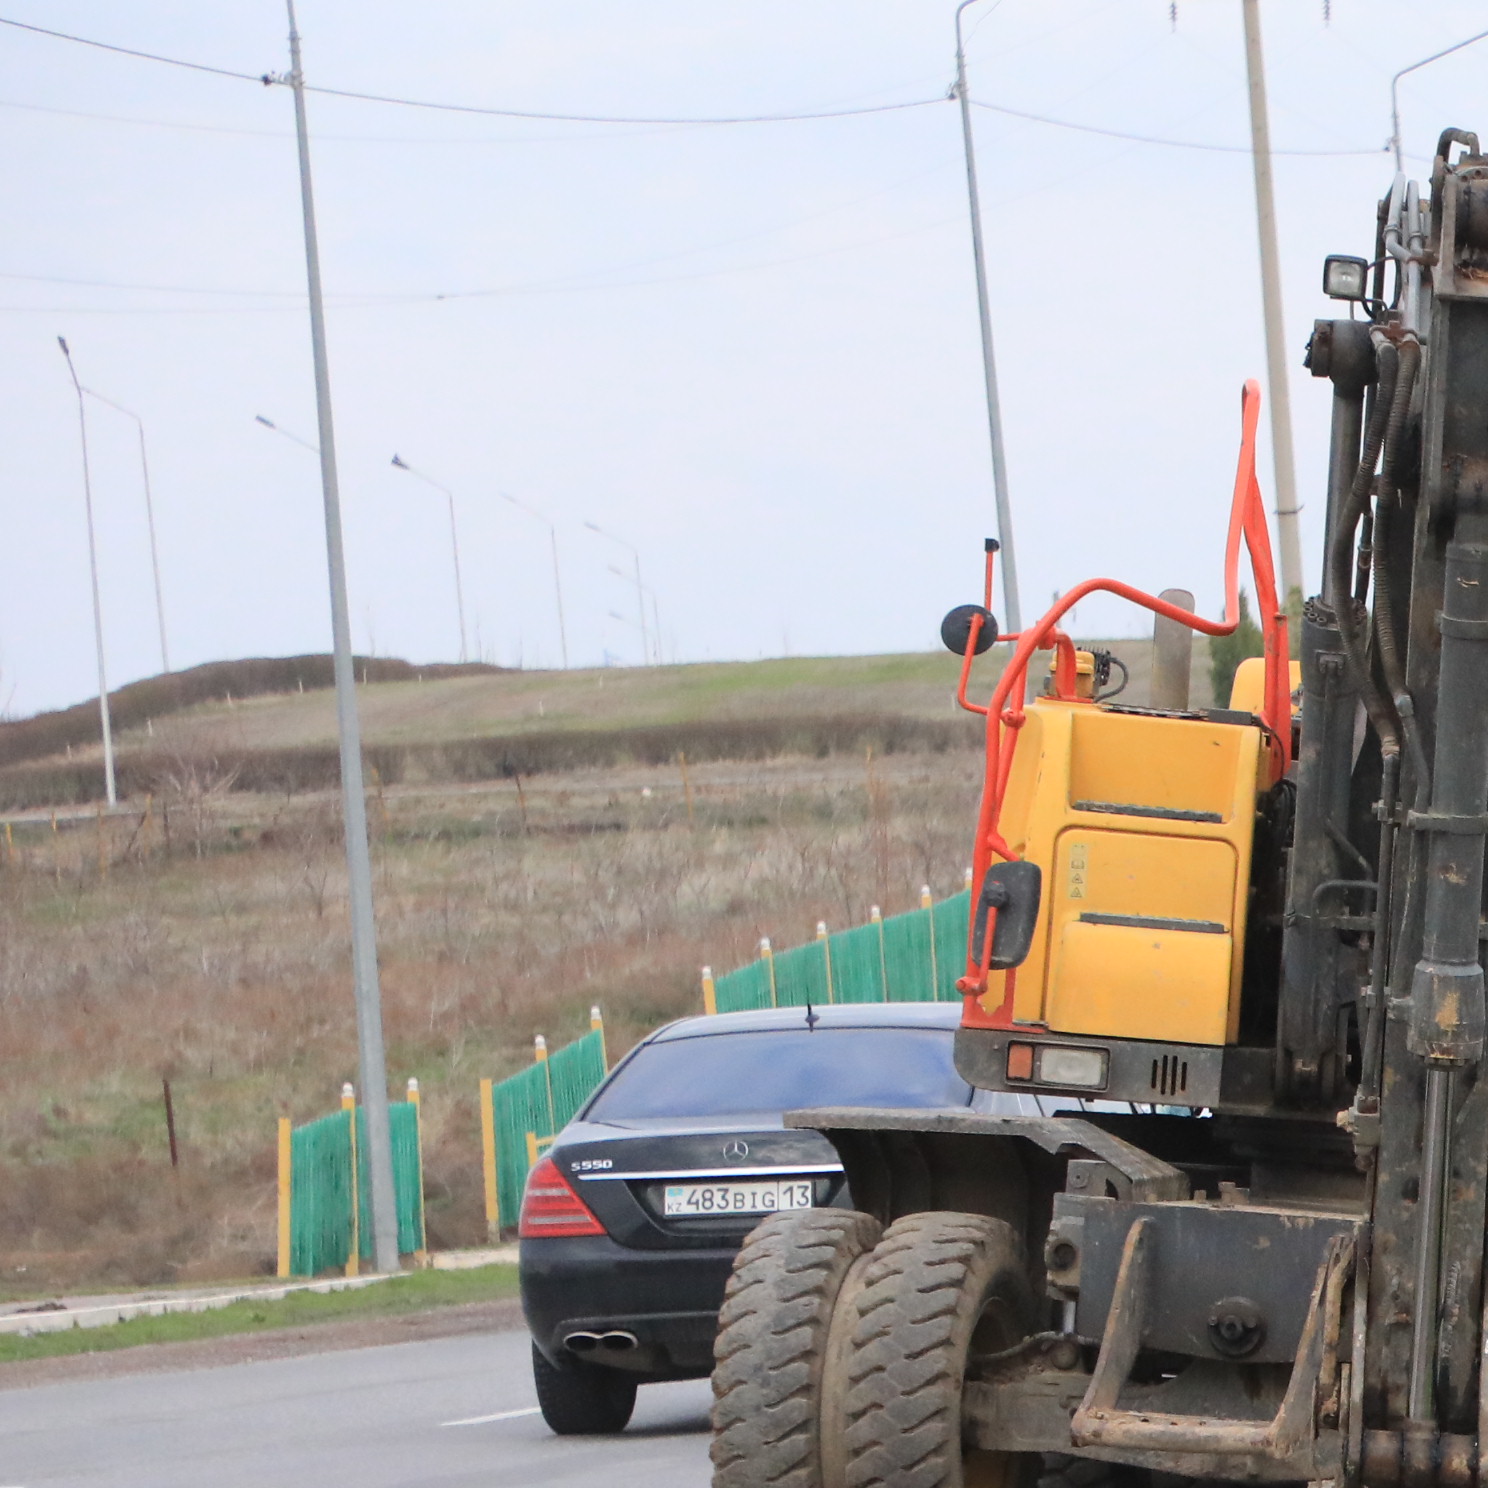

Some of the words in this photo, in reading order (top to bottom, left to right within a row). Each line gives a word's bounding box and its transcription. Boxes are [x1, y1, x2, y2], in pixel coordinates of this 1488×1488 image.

[570, 1159, 613, 1172] S550
[667, 1202, 682, 1212] KZ
[783, 1185, 810, 1208] 13
